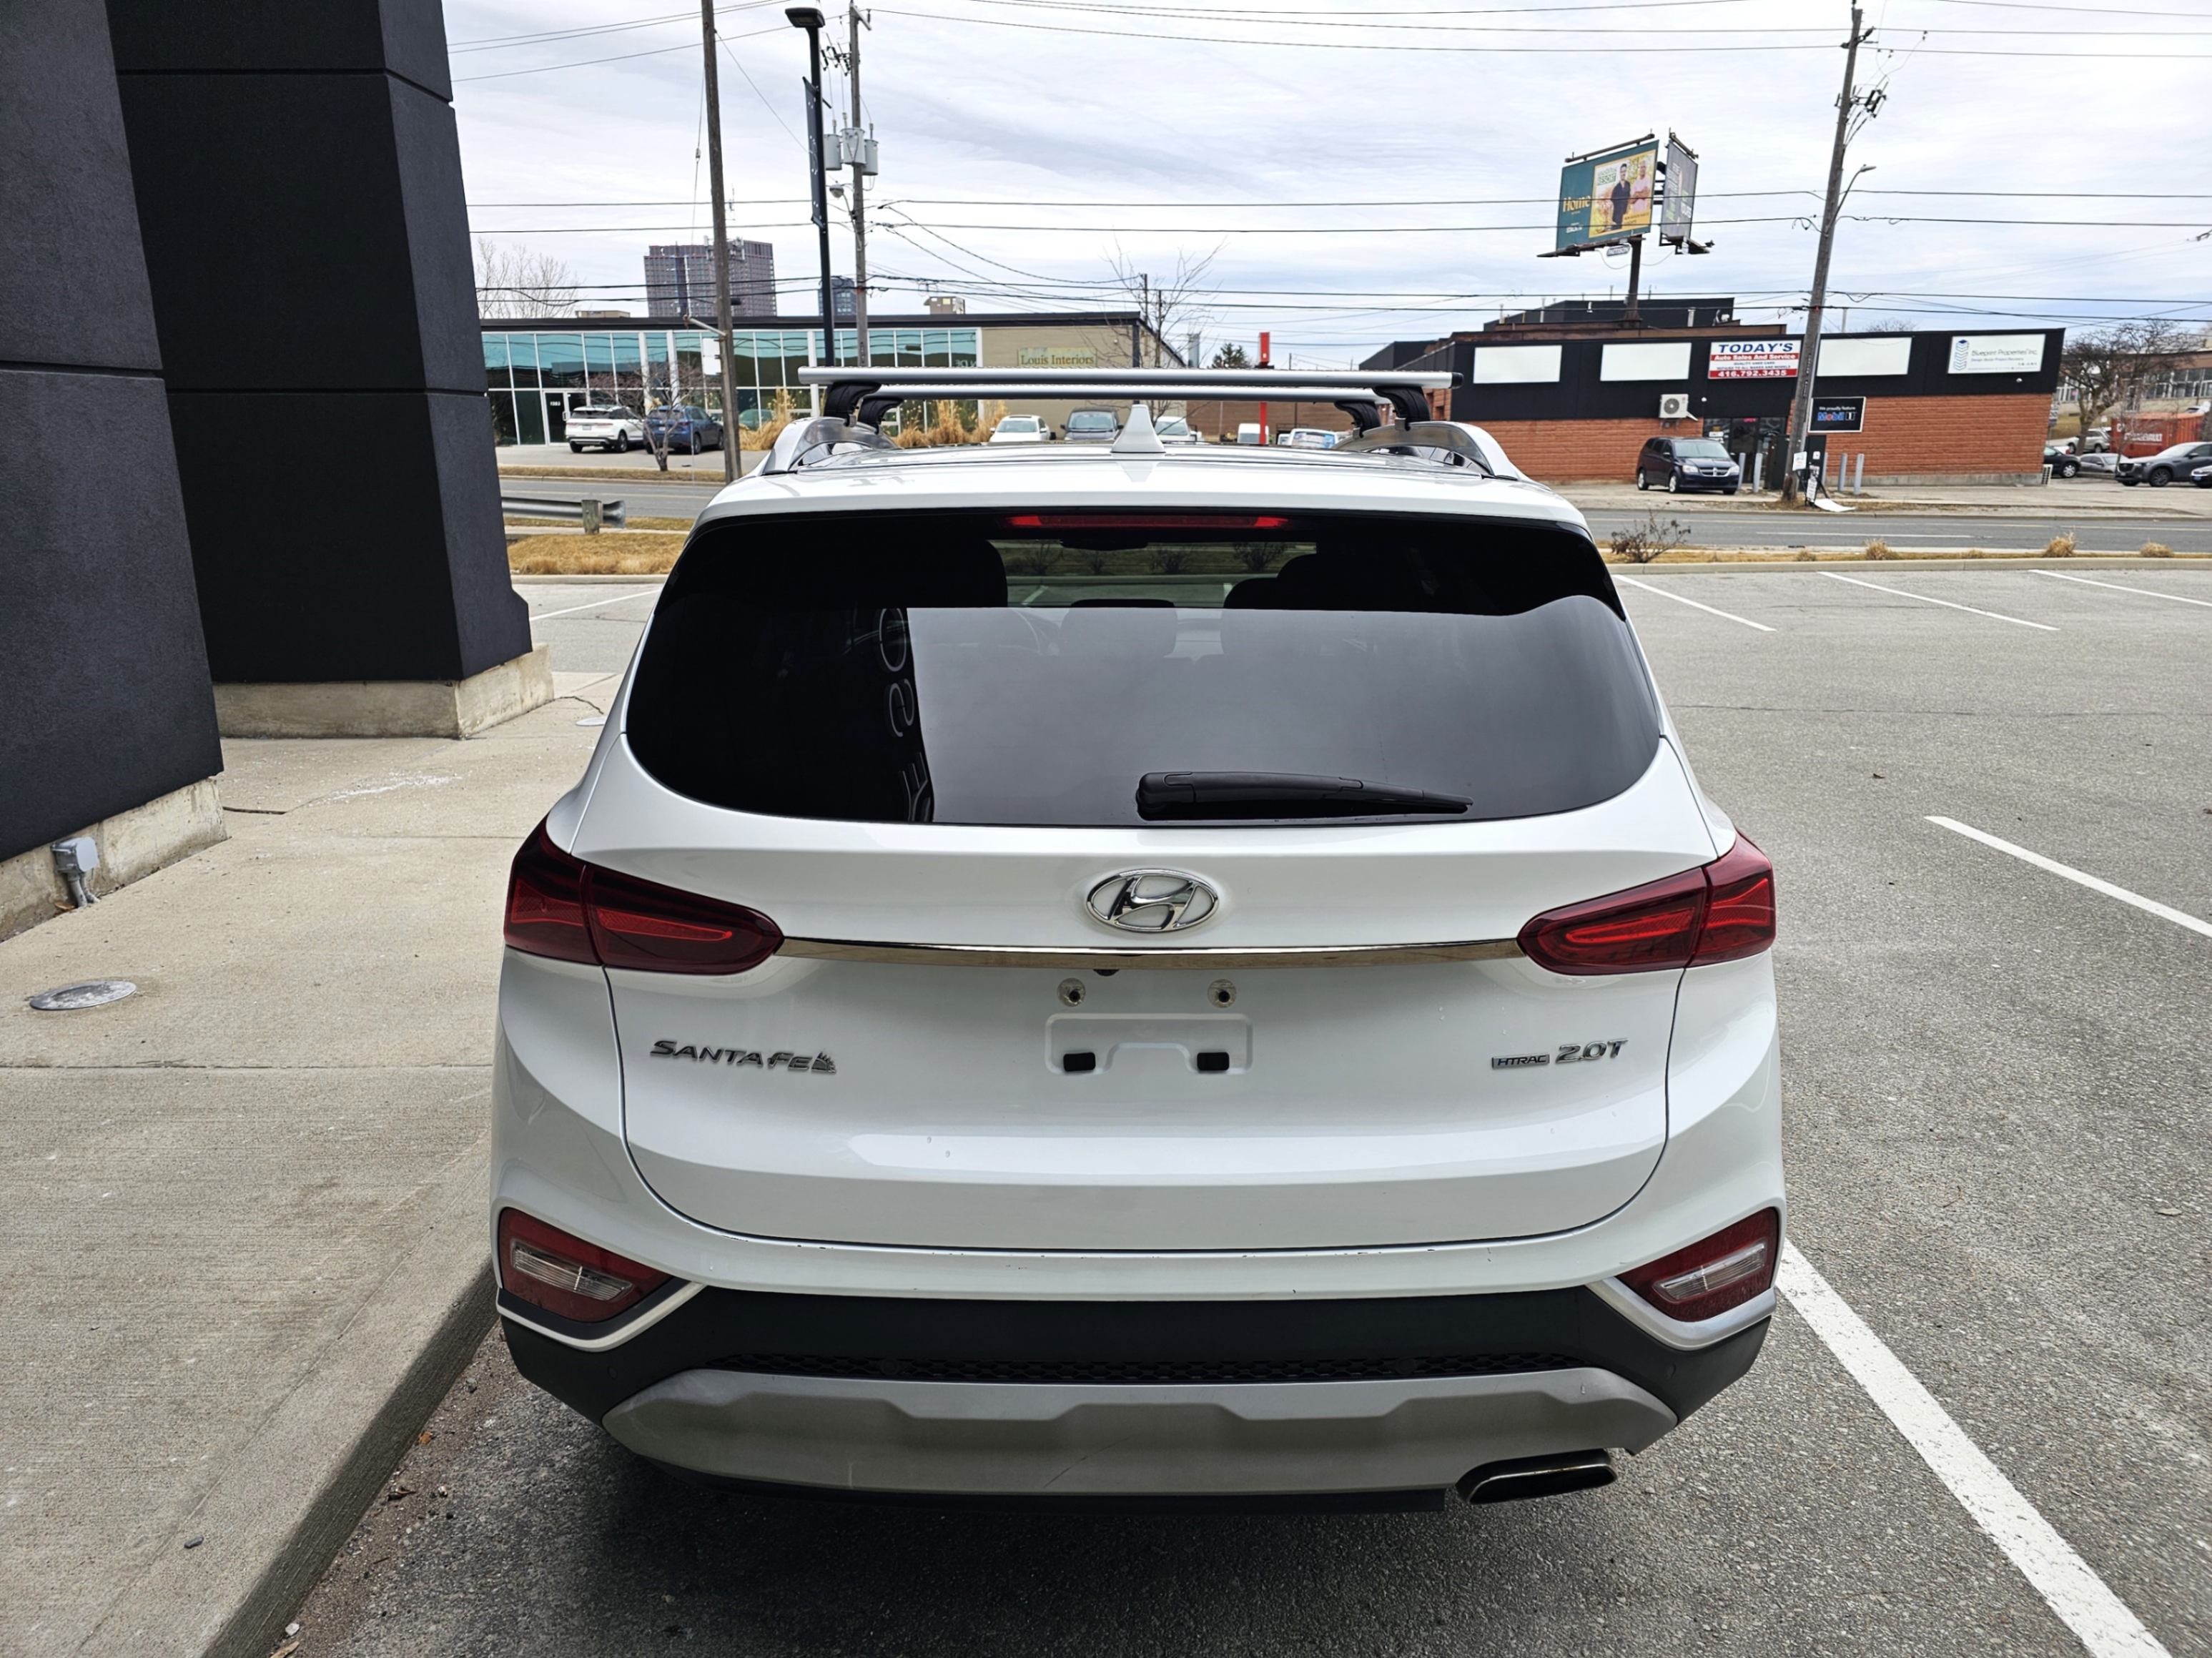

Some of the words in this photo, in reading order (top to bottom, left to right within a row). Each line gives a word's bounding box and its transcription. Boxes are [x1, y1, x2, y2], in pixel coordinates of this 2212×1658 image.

[1563, 194, 1591, 212] Home
[1719, 343, 1794, 353] TODAY'S
[1021, 355, 1048, 365] Louis
[1052, 354, 1094, 365] Interiors
[1817, 412, 1845, 421] Mobil
[1498, 1055, 1546, 1066] HTRAC
[1556, 1038, 1629, 1064] 2.0T
